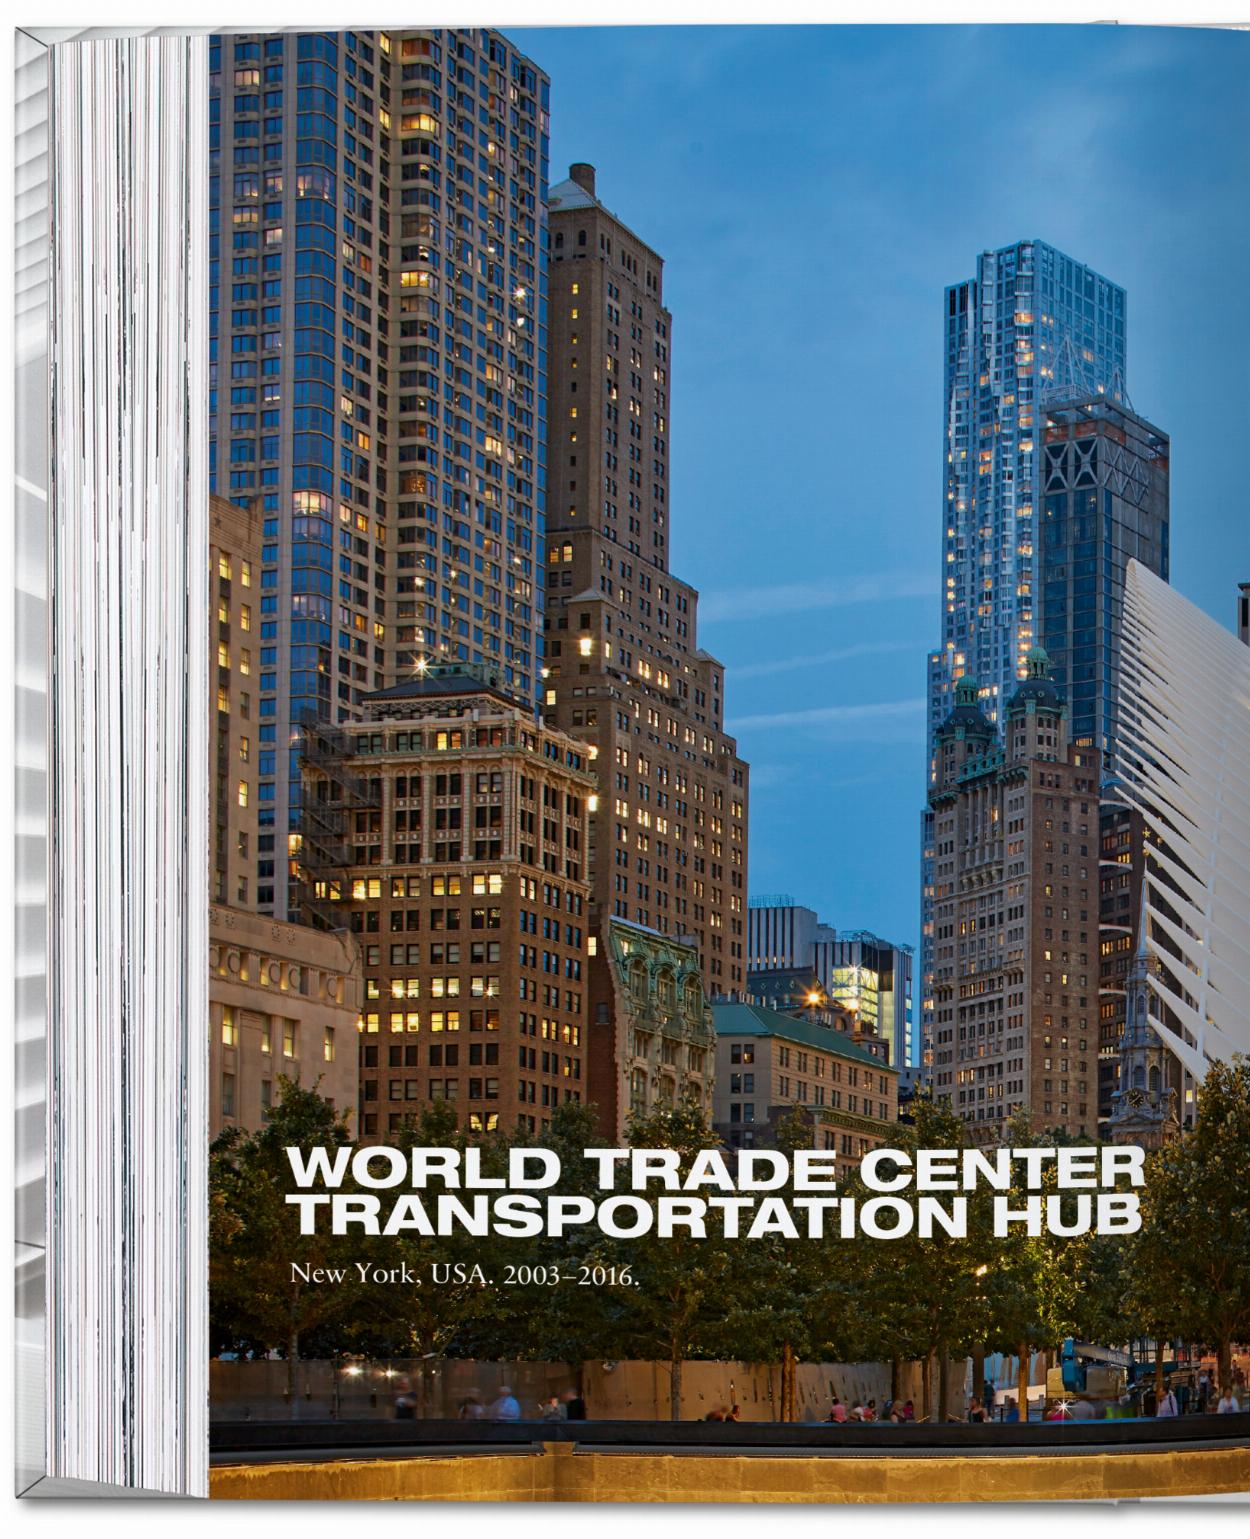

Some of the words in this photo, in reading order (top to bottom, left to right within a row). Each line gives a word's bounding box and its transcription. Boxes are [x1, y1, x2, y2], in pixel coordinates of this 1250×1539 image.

[285, 1146, 561, 1190] WORLD
[583, 1148, 837, 1191] TRADE
[860, 1145, 1147, 1192] CENTER
[285, 1193, 967, 1240] TRANSPORTATION
[993, 1193, 1143, 1238] HUB
[290, 1262, 347, 1284] New
[355, 1261, 423, 1288] York,
[430, 1263, 495, 1286] USA.
